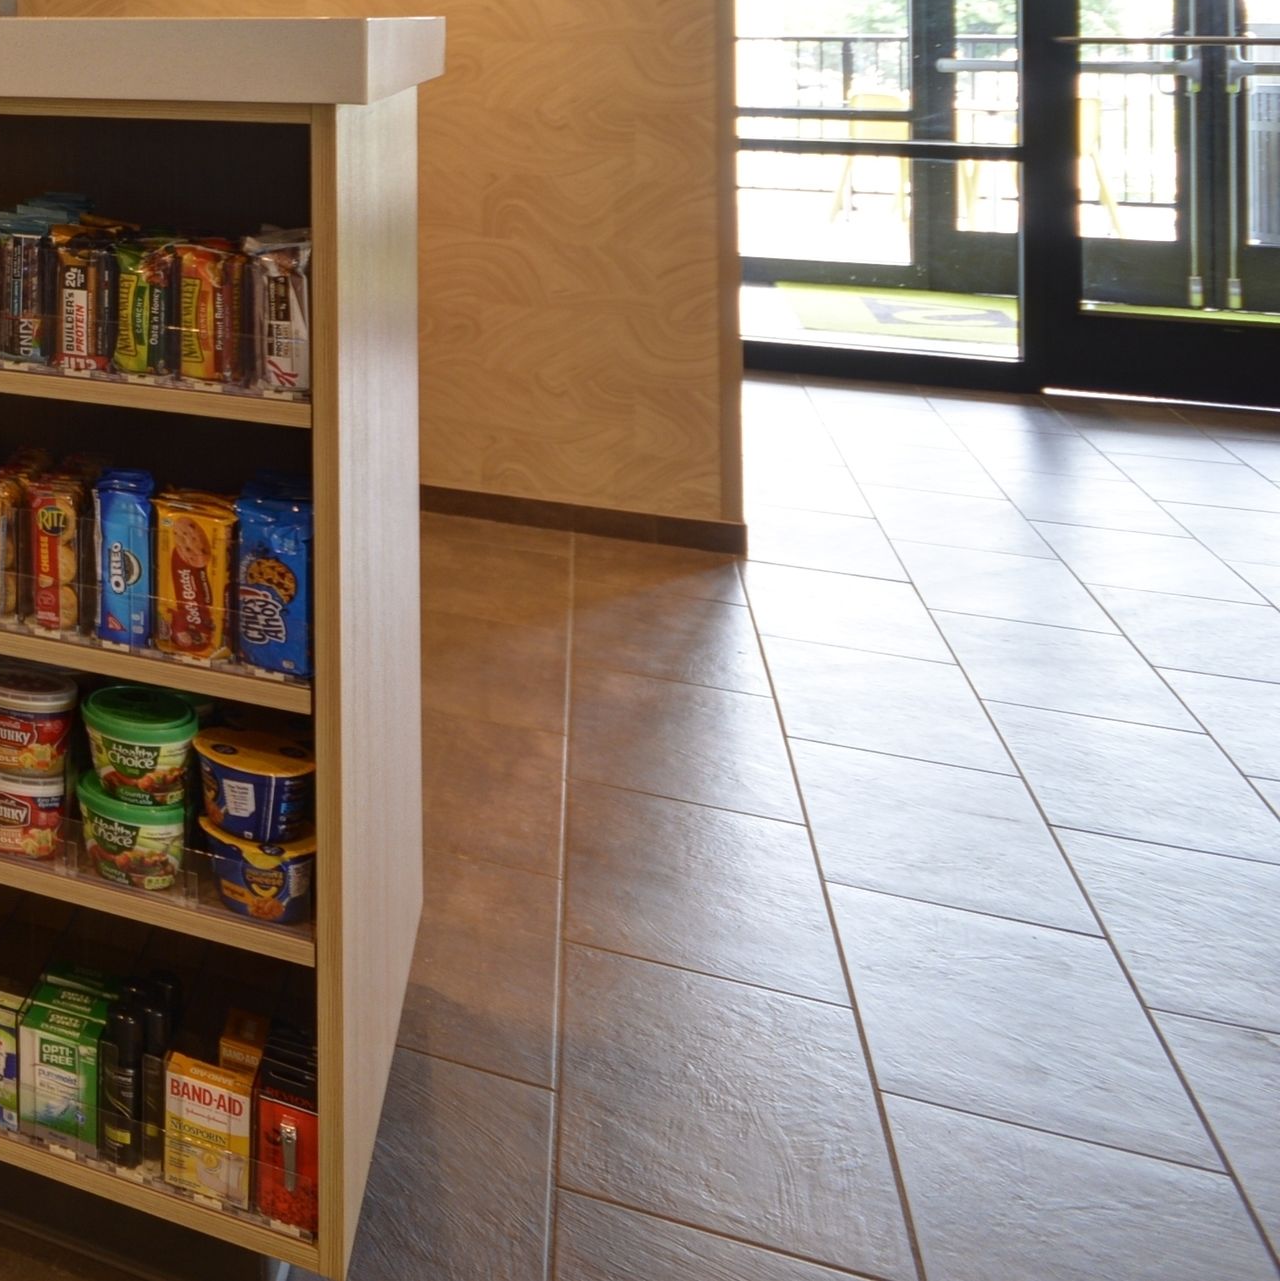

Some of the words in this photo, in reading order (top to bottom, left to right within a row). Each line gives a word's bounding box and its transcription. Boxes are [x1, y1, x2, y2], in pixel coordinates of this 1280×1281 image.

[118, 277, 135, 313] VALLEY
[20, 320, 33, 356] KIND
[75, 304, 85, 353] PROTEIN
[60, 357, 97, 370] CLIF
[39, 508, 66, 529] RITZ
[110, 542, 125, 594] OREO
[108, 751, 156, 769] Choice
[112, 742, 158, 759] Healthy
[42, 1043, 74, 1056] OPTI-
[42, 1054, 74, 1066] FREE
[171, 1078, 244, 1117] BAND-AID
[171, 1120, 227, 1146] NEOSPORIN
